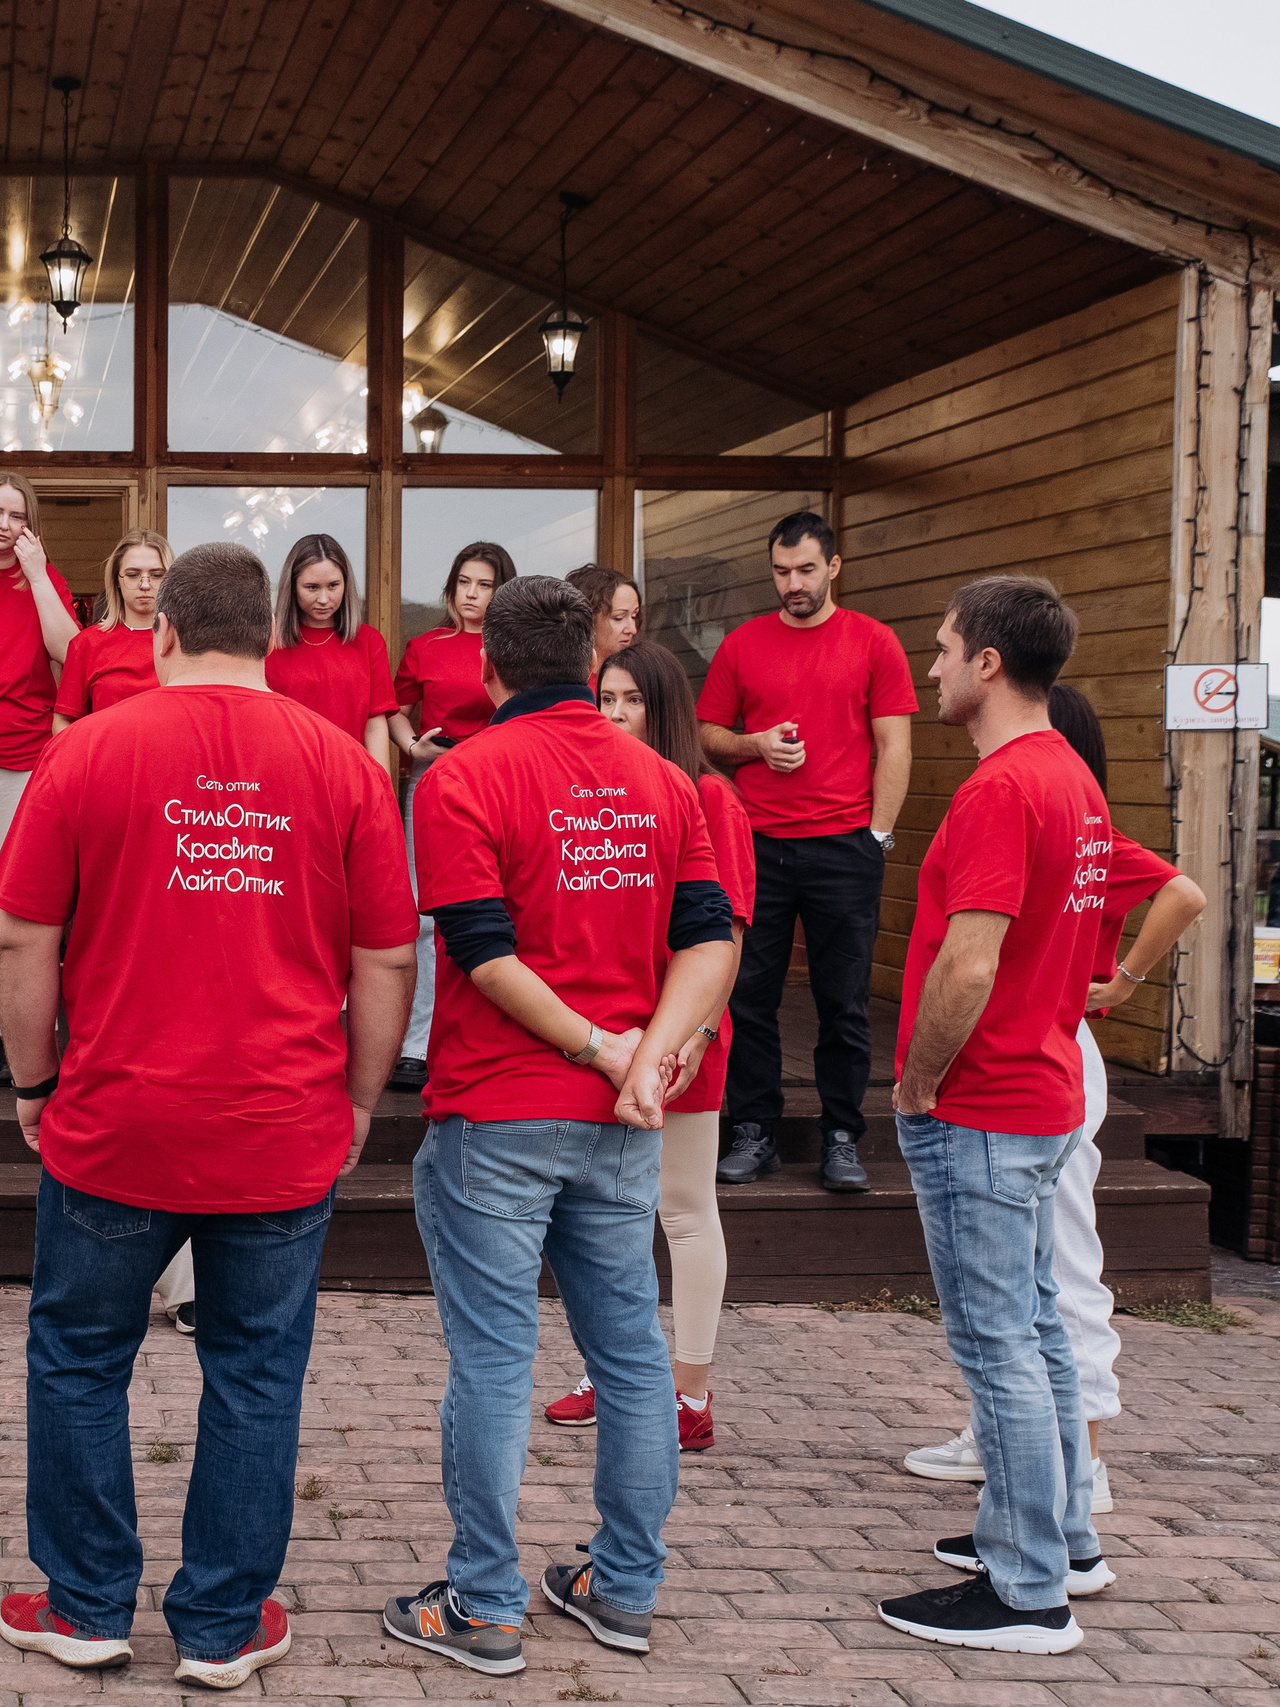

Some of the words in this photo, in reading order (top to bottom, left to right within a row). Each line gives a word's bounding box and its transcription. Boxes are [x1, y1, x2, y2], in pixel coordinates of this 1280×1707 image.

[196, 774, 223, 791] Сеть
[226, 781, 261, 792] оптик
[570, 784, 594, 798] Сеть
[596, 787, 628, 797] оптик
[164, 799, 292, 832] СтильОптик
[549, 808, 658, 832] СтильОптик
[167, 865, 285, 896] ЛайтОптик
[556, 867, 655, 892] ЛайтОптик
[572, 1569, 592, 1597] N
[419, 1604, 446, 1638] N
